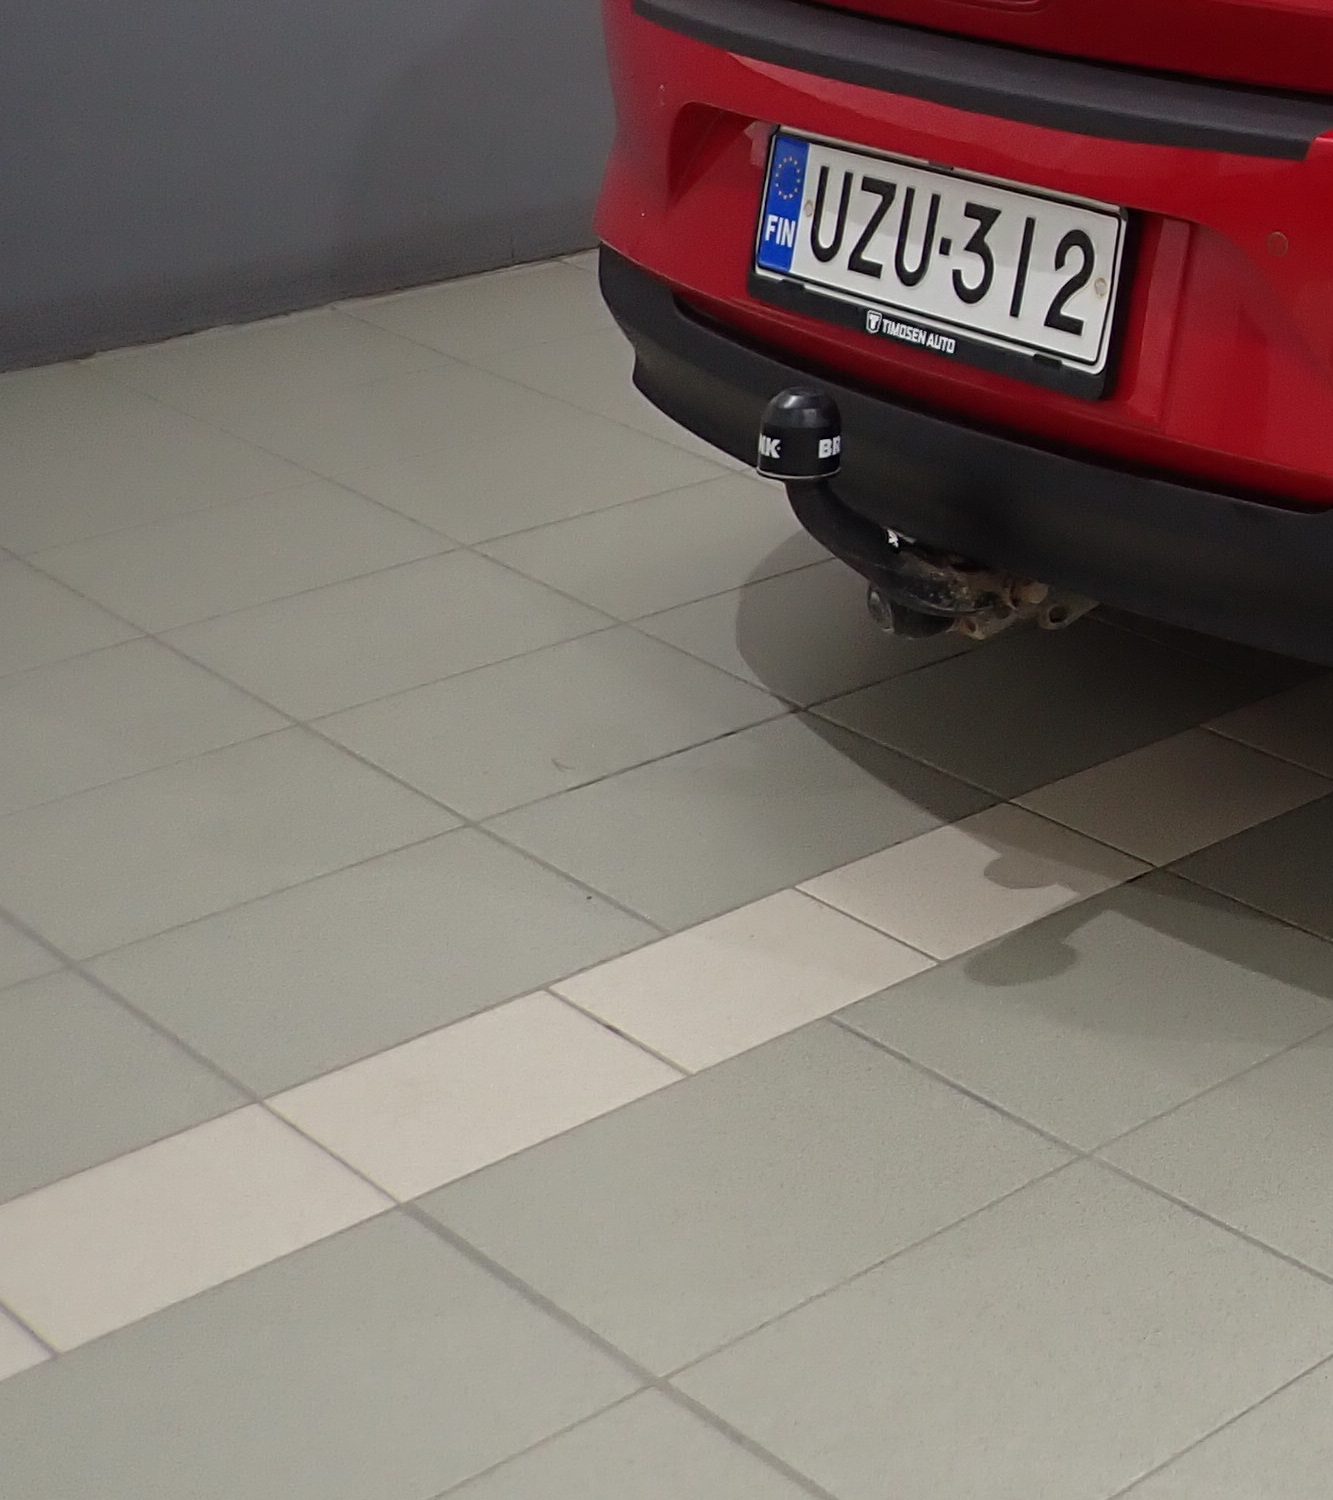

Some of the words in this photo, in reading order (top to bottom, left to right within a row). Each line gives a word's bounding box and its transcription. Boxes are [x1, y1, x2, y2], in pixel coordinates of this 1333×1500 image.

[764, 214, 797, 249] FIN
[809, 165, 1096, 337] UZU-312
[882, 318, 928, 345] TIMOSEN
[926, 333, 956, 354] AUTO
